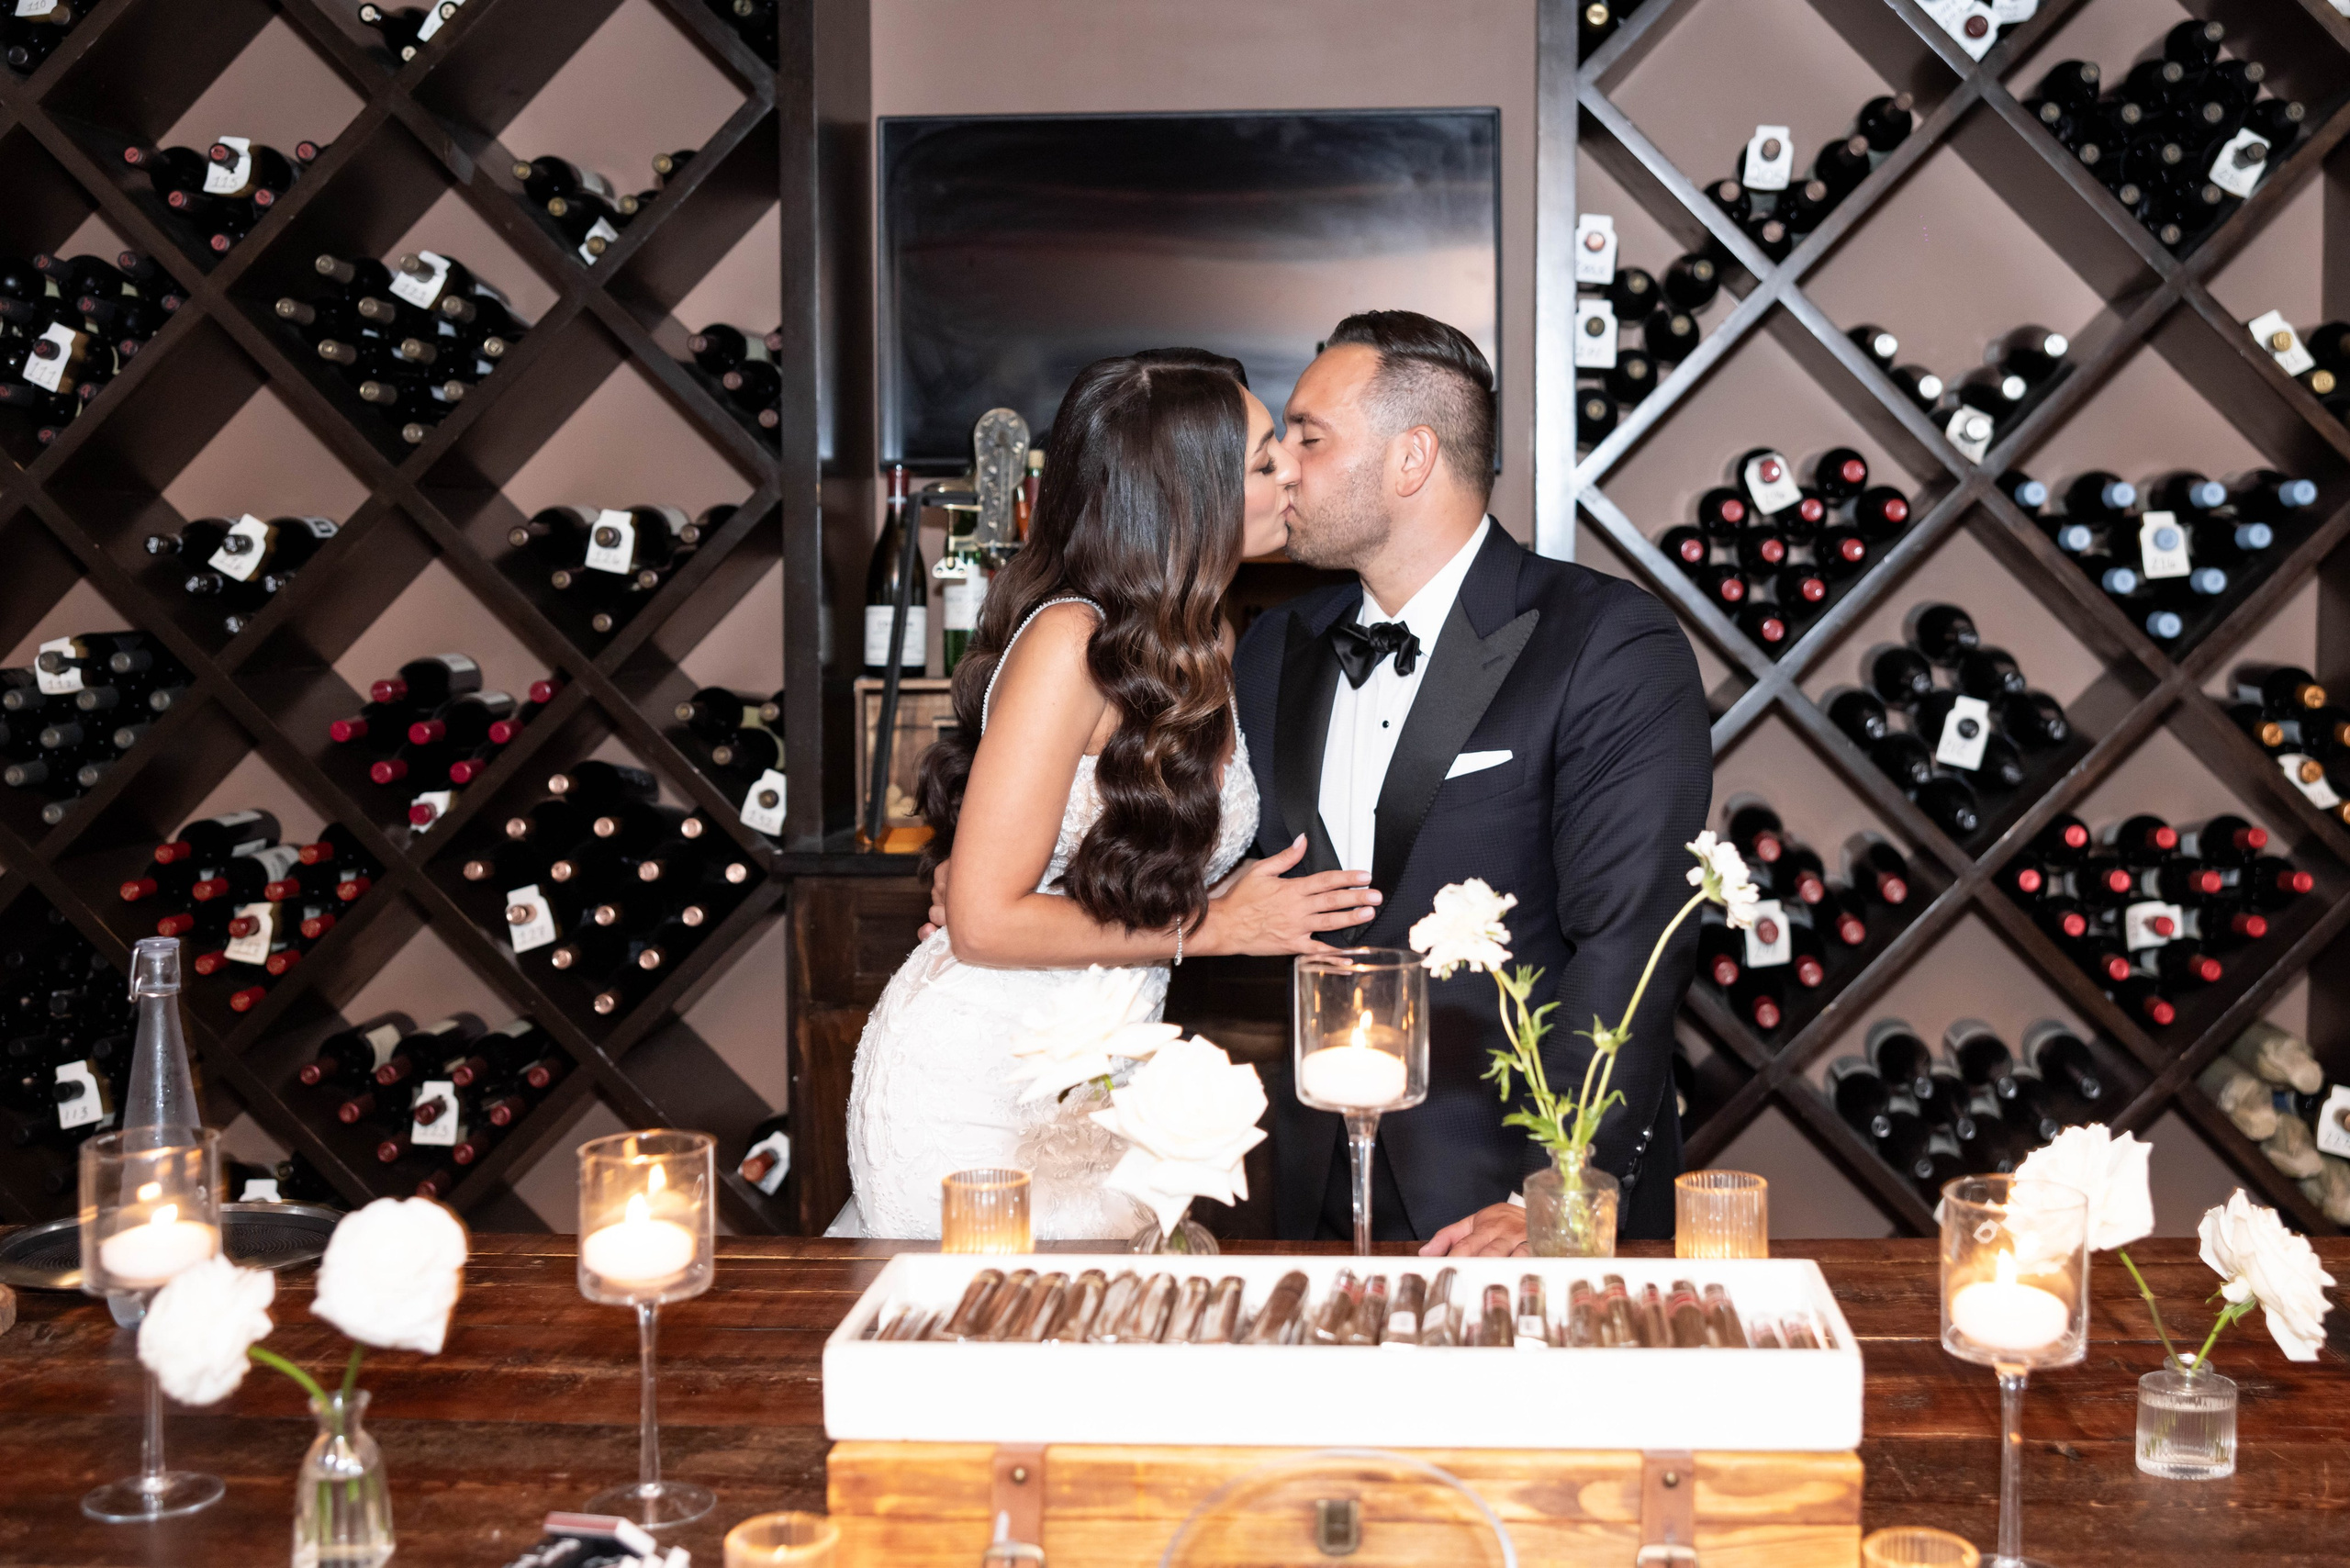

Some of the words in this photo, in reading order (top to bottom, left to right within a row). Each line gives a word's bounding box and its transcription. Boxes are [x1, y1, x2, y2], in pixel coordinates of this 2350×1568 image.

[27, 0, 47, 13] 110
[211, 175, 241, 189] 115
[27, 361, 57, 386] 111
[64, 1104, 90, 1122] 113
